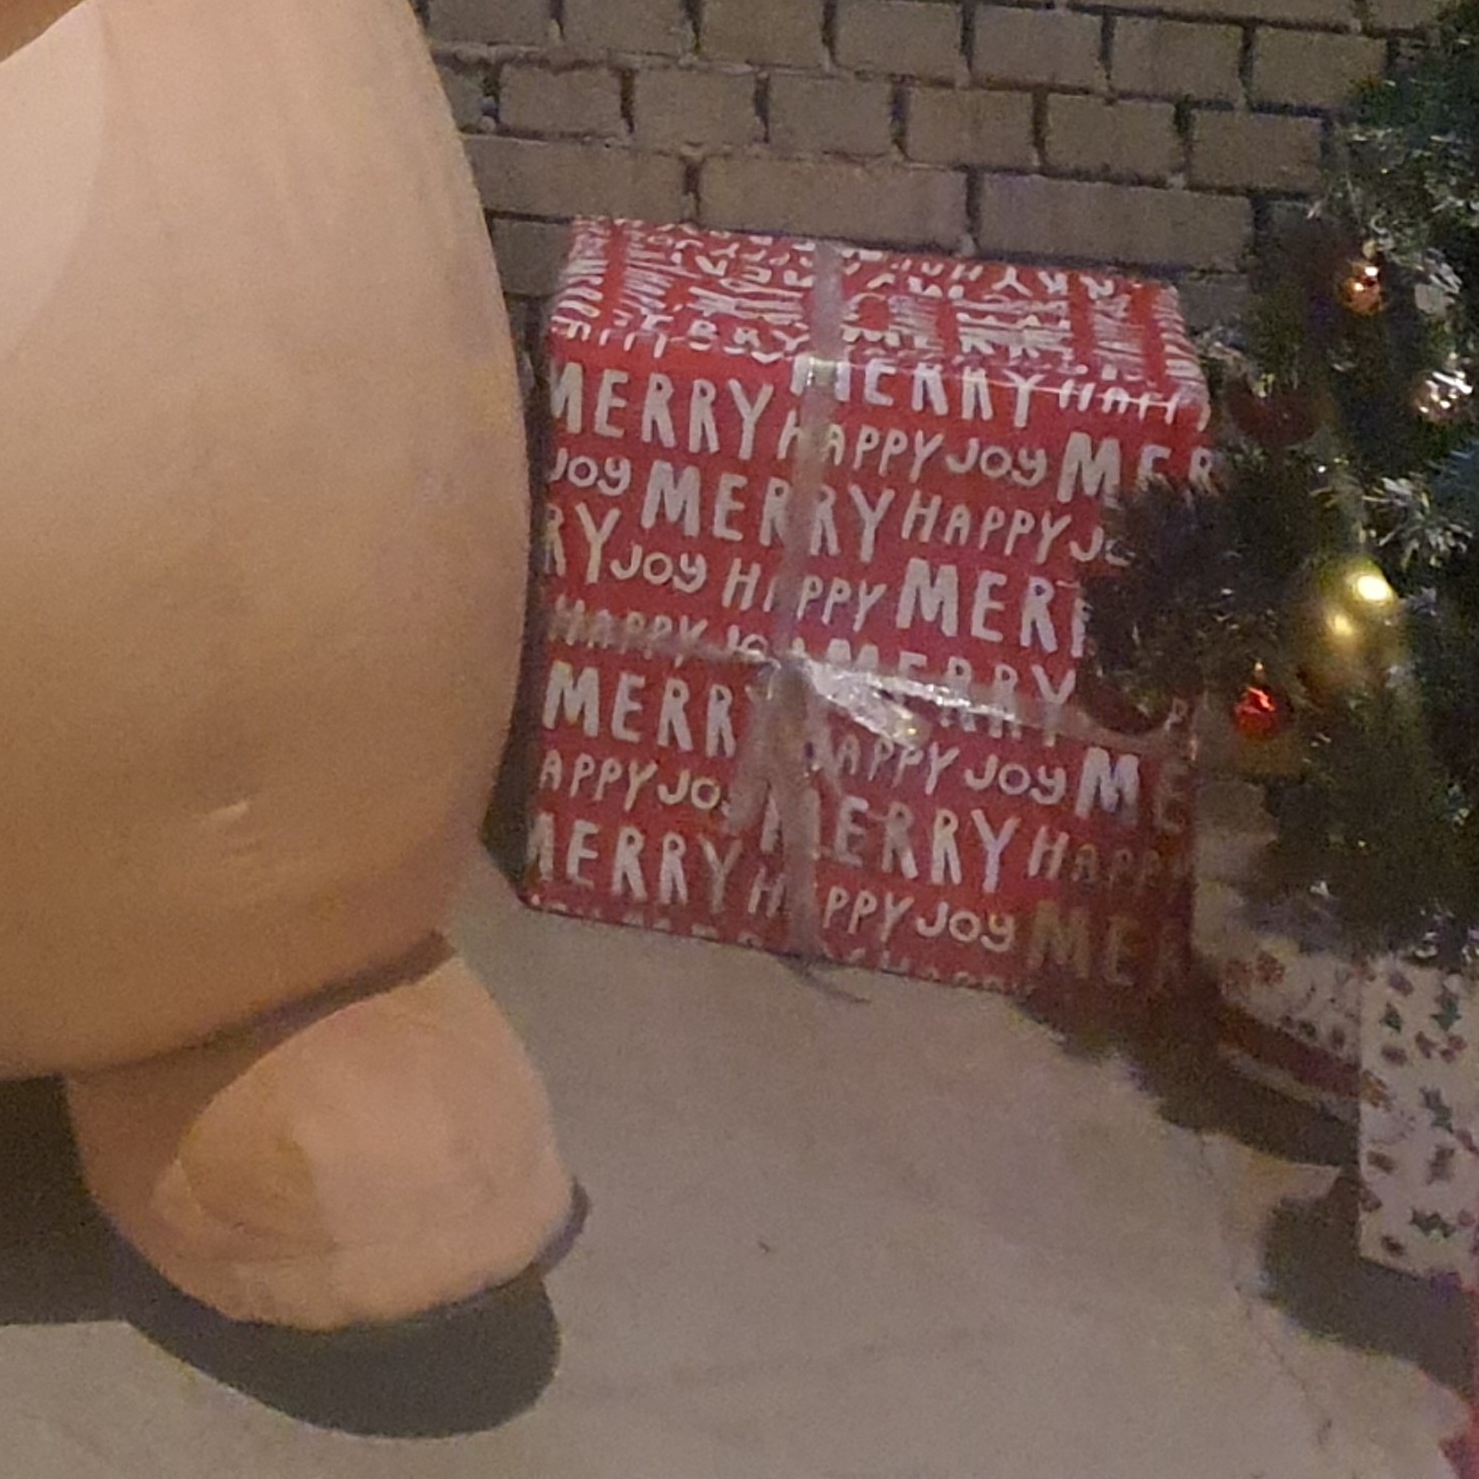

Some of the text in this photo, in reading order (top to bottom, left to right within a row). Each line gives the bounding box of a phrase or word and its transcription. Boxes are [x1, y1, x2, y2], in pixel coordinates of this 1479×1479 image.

[550, 362, 774, 460] MERRY
[642, 460, 896, 563] MERRY
[902, 490, 1072, 564] HAPPY
[657, 770, 733, 818] JO
[748, 865, 915, 945] HPPY
